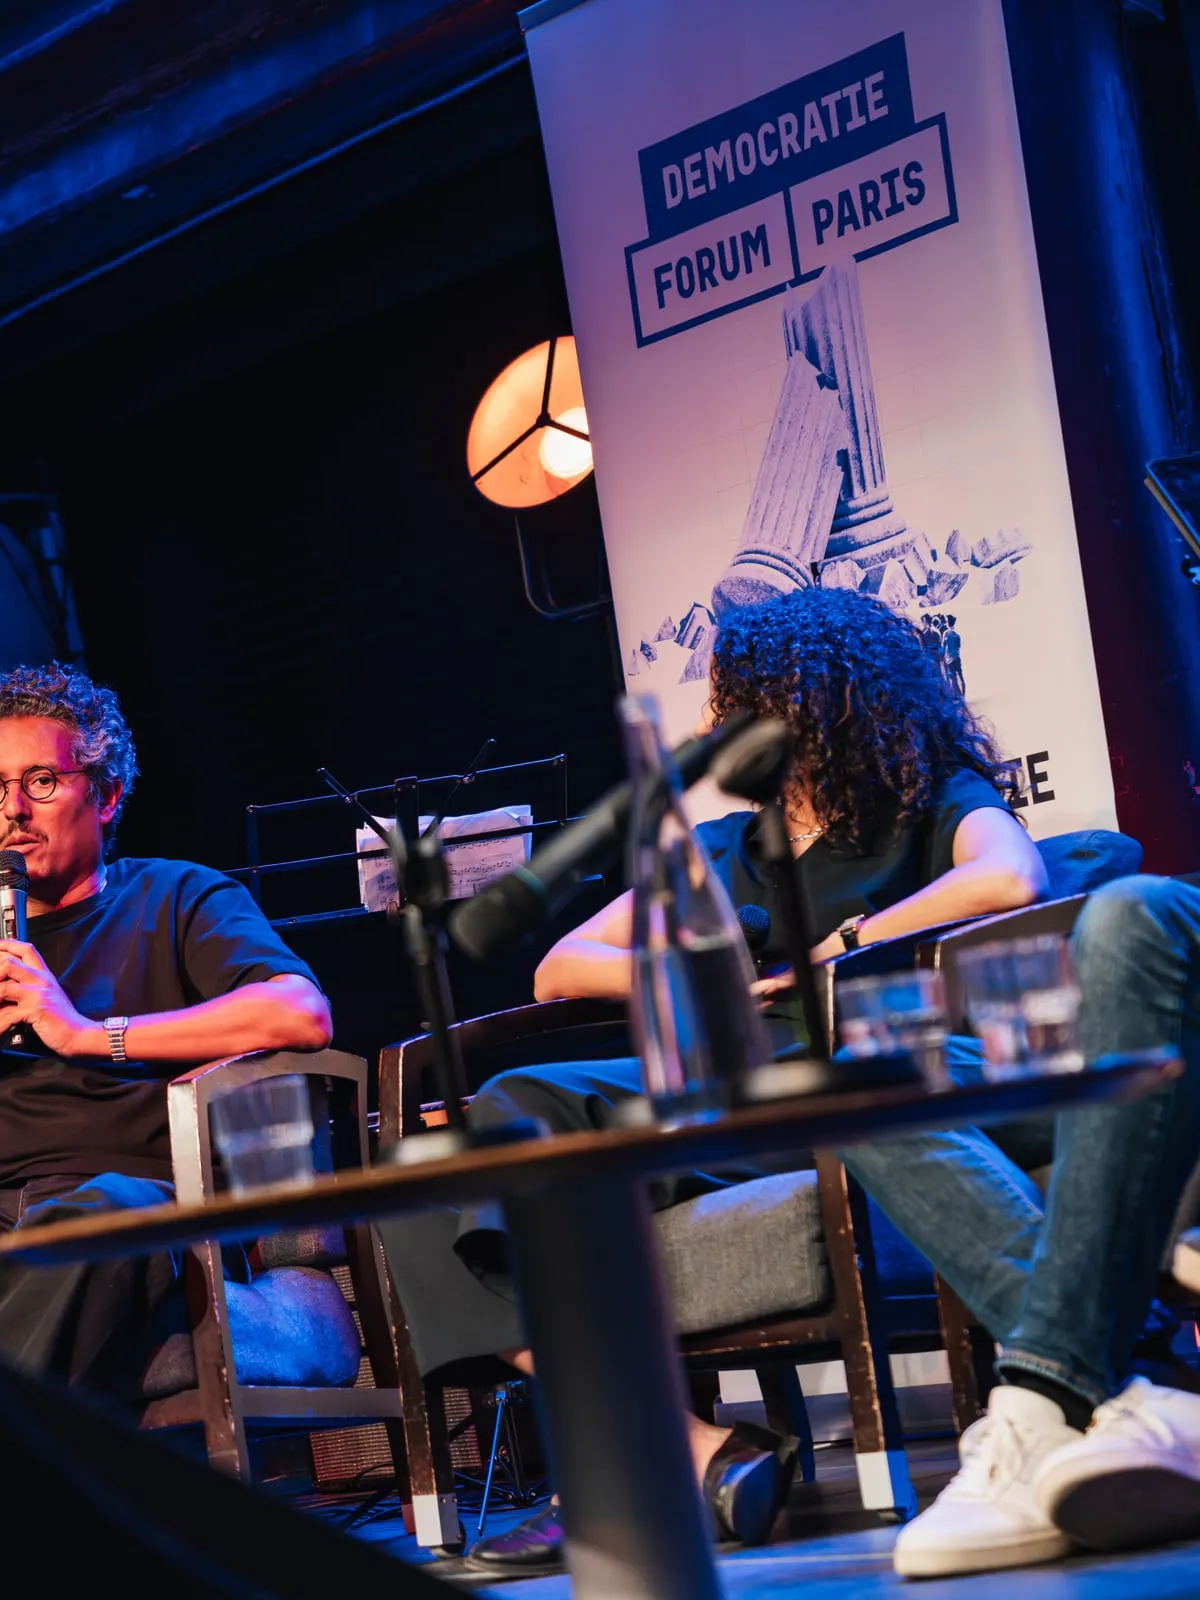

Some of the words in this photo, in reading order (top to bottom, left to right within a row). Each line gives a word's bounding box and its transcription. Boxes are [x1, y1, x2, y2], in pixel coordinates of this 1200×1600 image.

[662, 70, 889, 210] DEMOCRATIE
[654, 224, 771, 309] FORUM
[812, 160, 926, 246] PARIS
